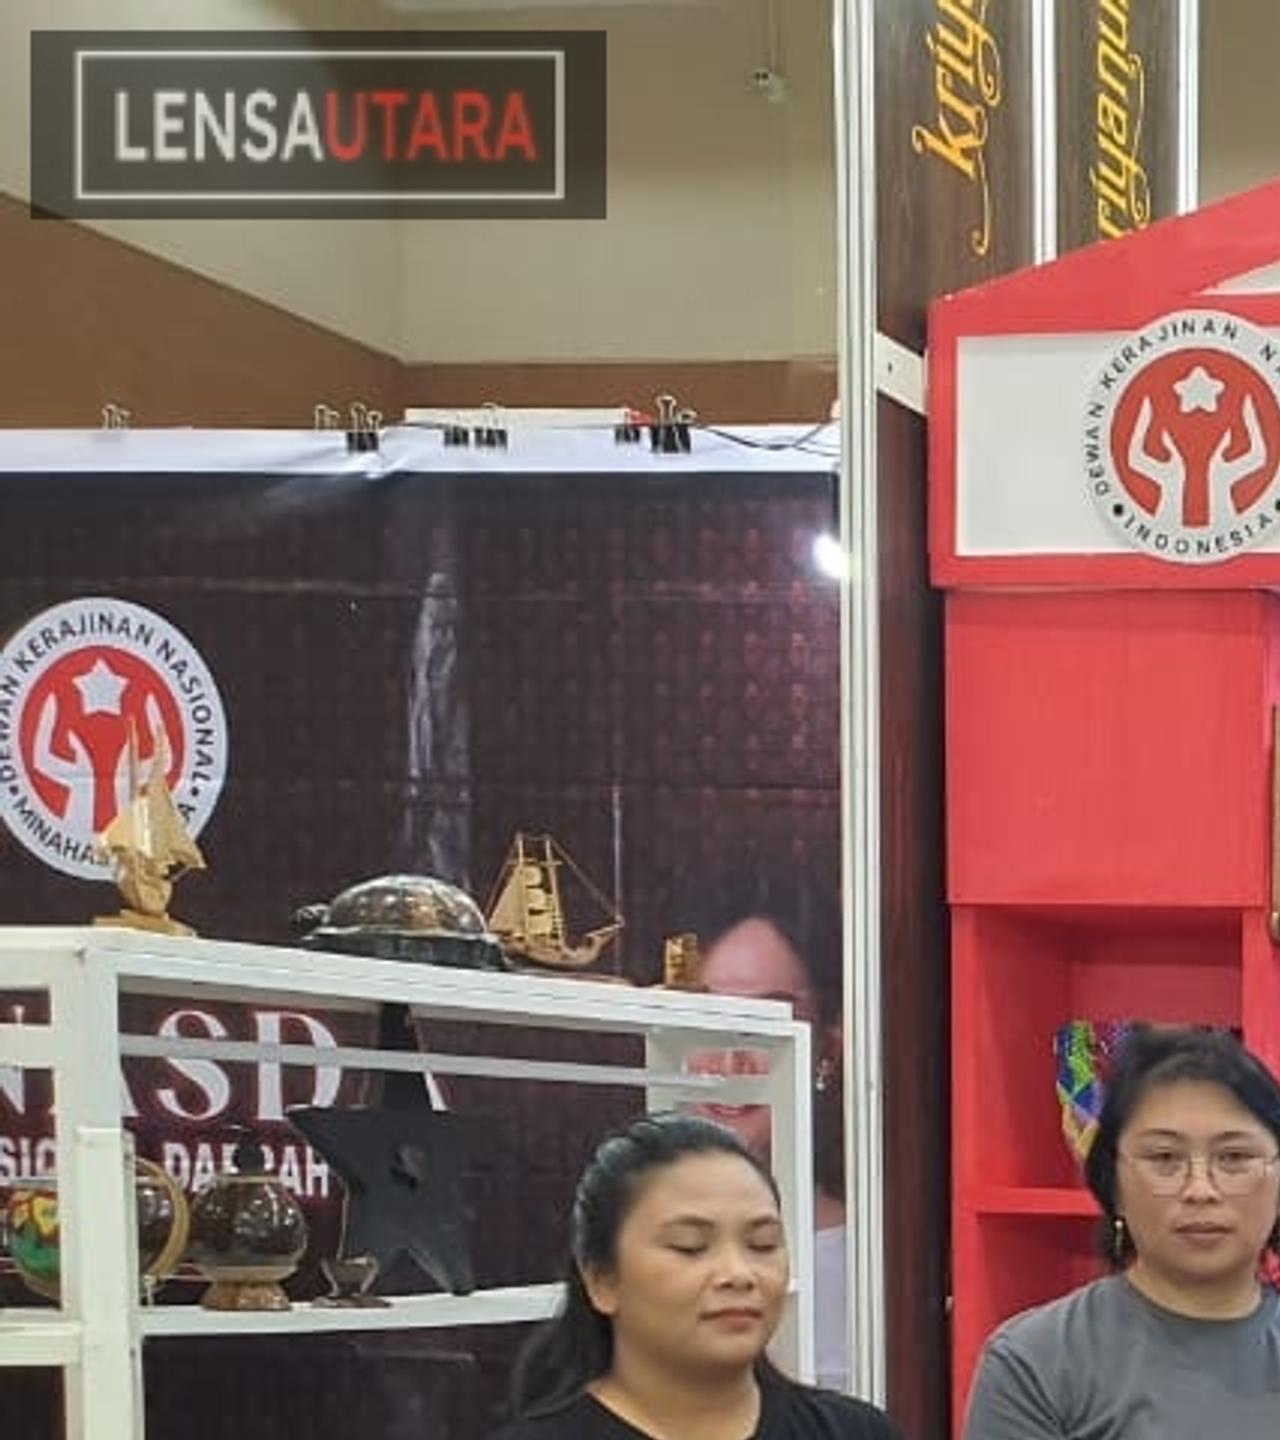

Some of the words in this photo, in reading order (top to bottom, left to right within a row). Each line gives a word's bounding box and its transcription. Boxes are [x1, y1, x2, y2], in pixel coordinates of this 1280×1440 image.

[1089, 0, 1150, 239] riyanu
[1083, 403, 1110, 496] DEWAN
[1101, 317, 1239, 390] KERAJINAN
[1123, 513, 1273, 555] INDONESIA
[13, 611, 155, 673] KERAJINAN
[156, 638, 216, 783] NASIONAL
